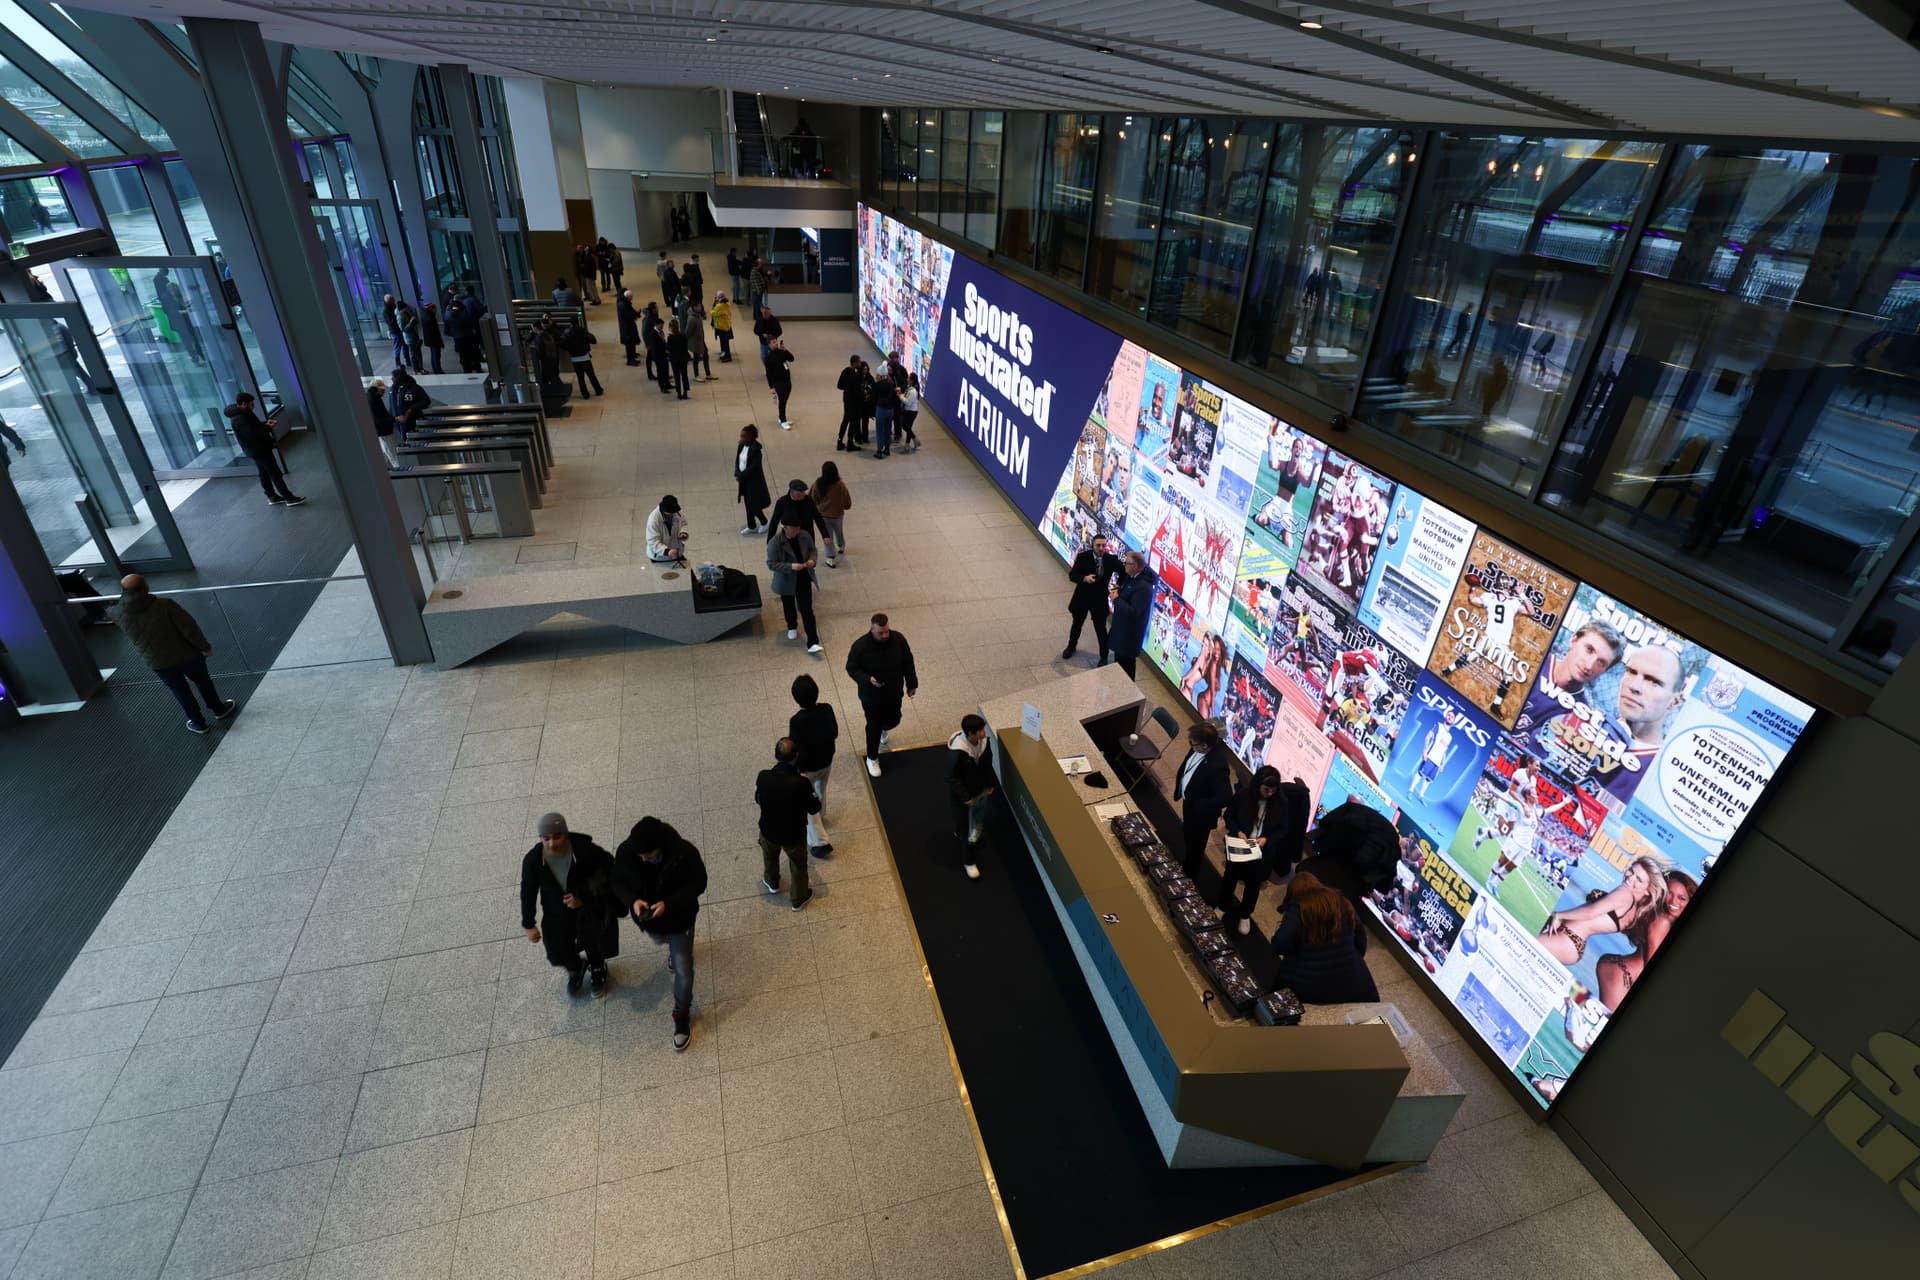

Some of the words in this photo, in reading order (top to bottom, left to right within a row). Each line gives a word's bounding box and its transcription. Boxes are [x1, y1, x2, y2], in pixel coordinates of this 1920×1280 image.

[965, 282, 1033, 366] Sports
[1191, 381, 1221, 412] Sports
[957, 377, 1030, 488] ATRIUM
[1411, 536, 1457, 569] MANCHESTER
[1420, 515, 1464, 544] TOTTENHAM
[1422, 526, 1455, 550] HOTSPUR
[1417, 551, 1443, 572] UNITED
[1475, 538, 1570, 597] CHAMPIONS
[1490, 601, 1509, 626] 9
[1445, 602, 1538, 686] Saints
[1415, 680, 1492, 751] SPURS
[1535, 674, 1606, 731] west
[1544, 714, 1622, 781] story
[1575, 716, 1646, 775] side
[1689, 732, 1769, 787] TOTTENHAM
[1692, 748, 1753, 791] HOTSPUR
[1676, 774, 1737, 819] ATHLETIC
[1415, 835, 1475, 904] Sports
[1419, 858, 1473, 921] trated
[1526, 846, 1570, 888] CLASS
[1419, 910, 1444, 940] PHOTOS
[1423, 898, 1454, 933] GREATEST
[1720, 988, 1920, 1215] Illu
